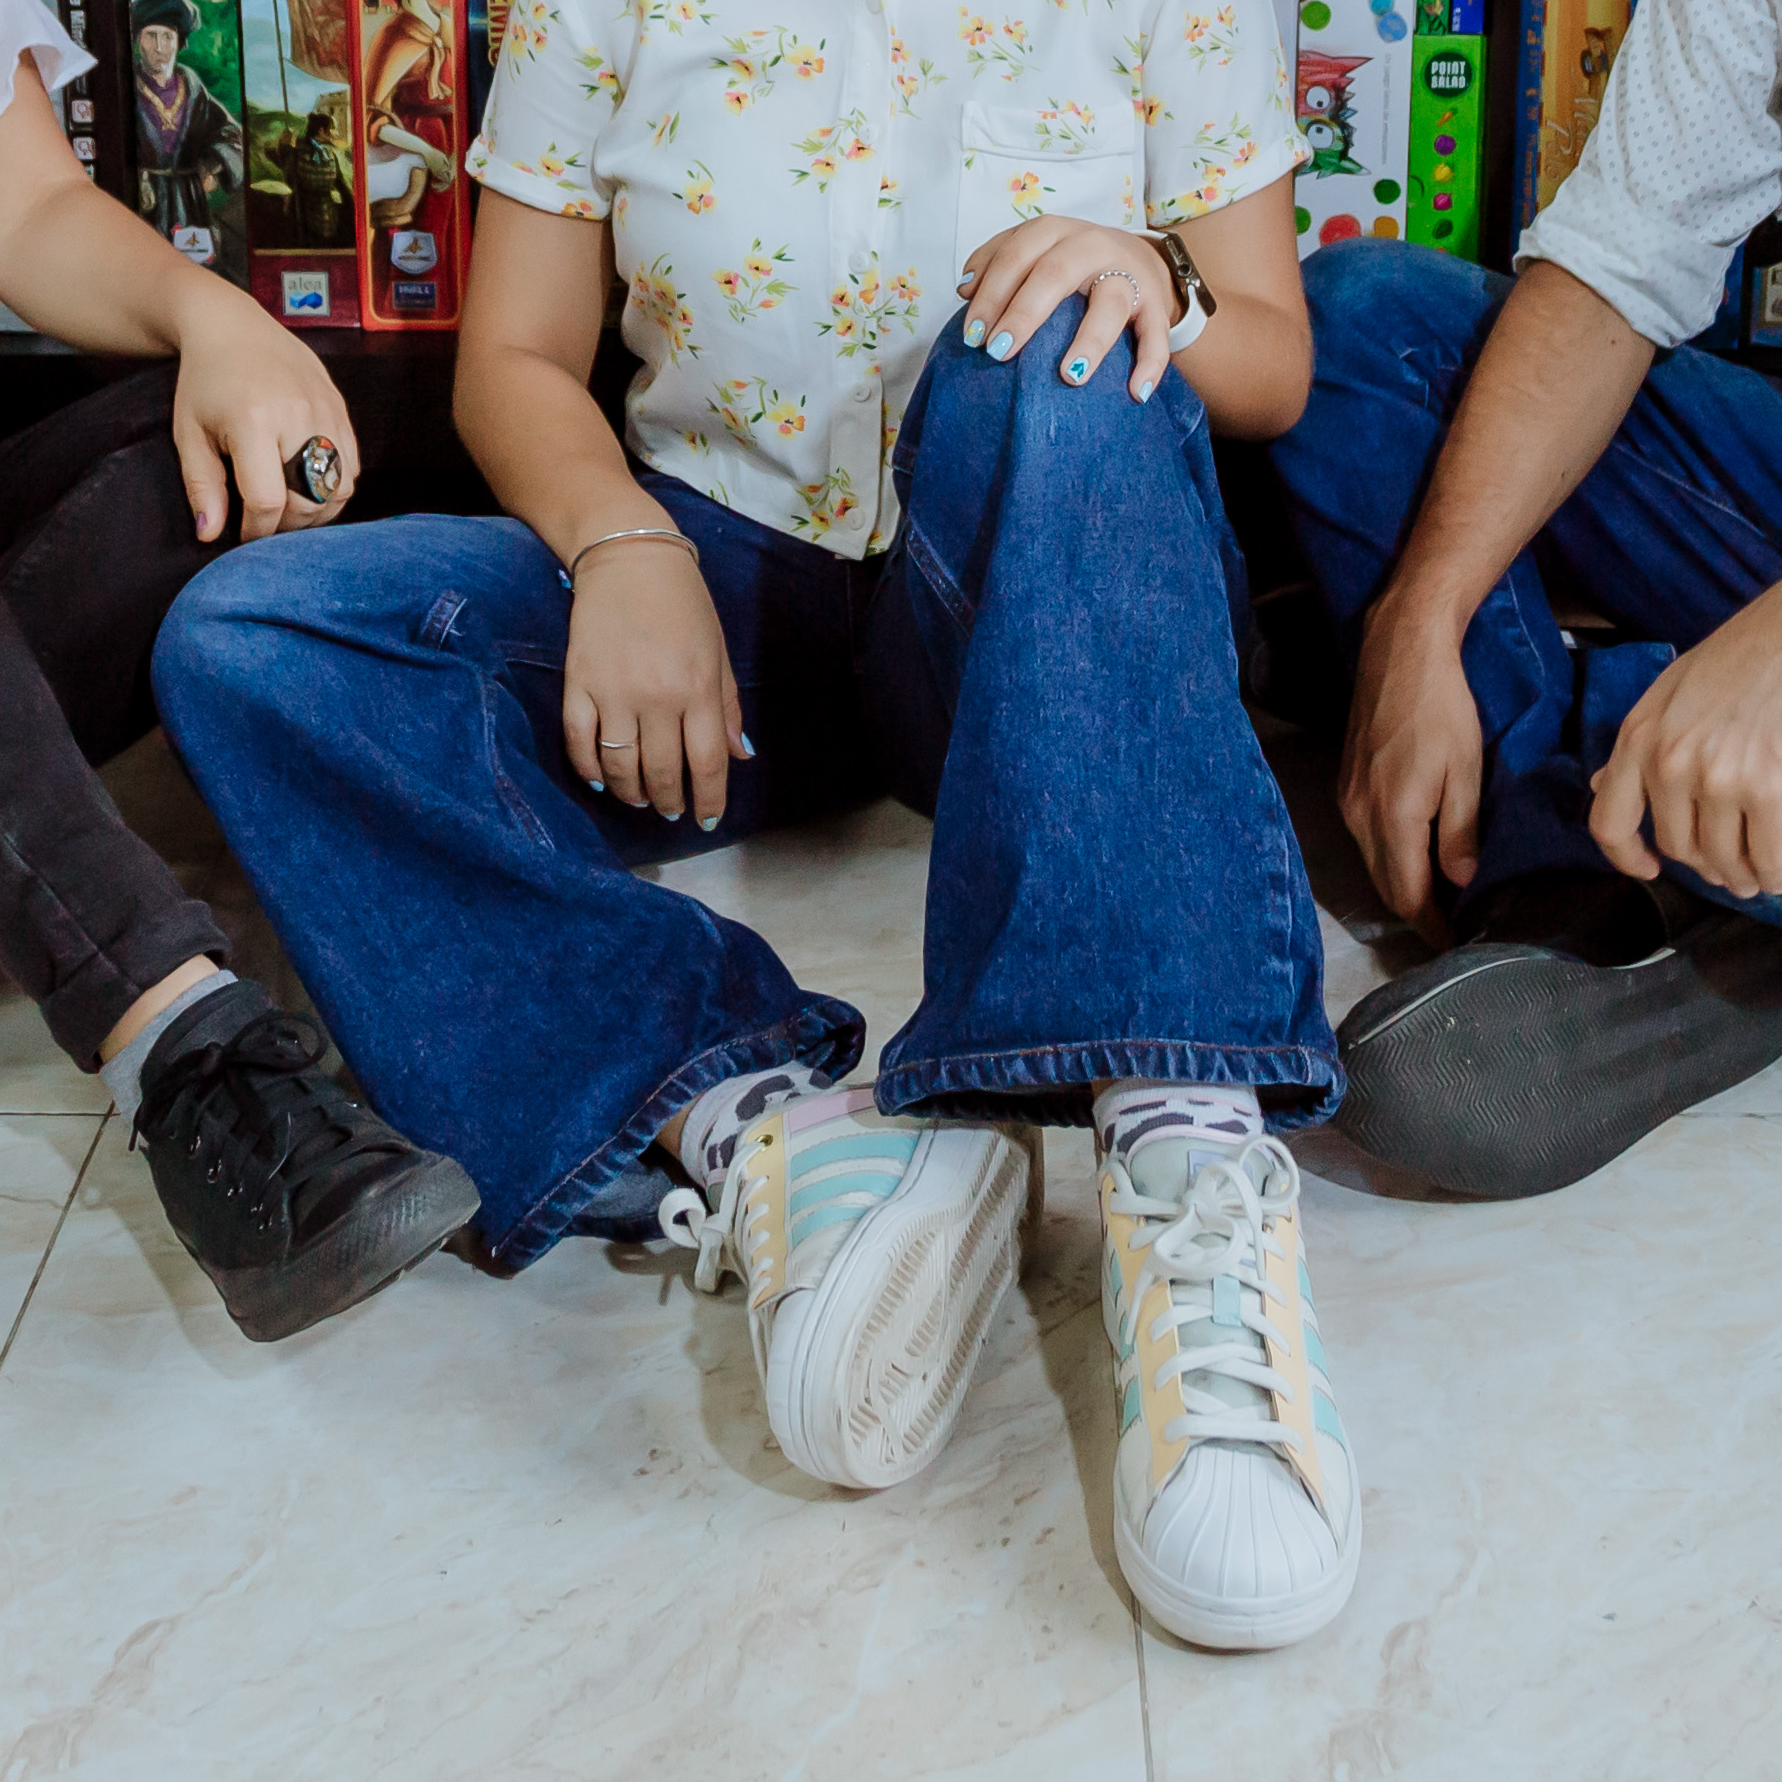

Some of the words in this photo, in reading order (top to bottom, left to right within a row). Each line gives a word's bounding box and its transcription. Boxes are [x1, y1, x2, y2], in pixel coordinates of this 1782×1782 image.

[1431, 61, 1466, 75] POINT
[1431, 75, 1467, 89] SALAD
[288, 276, 322, 292] alea
